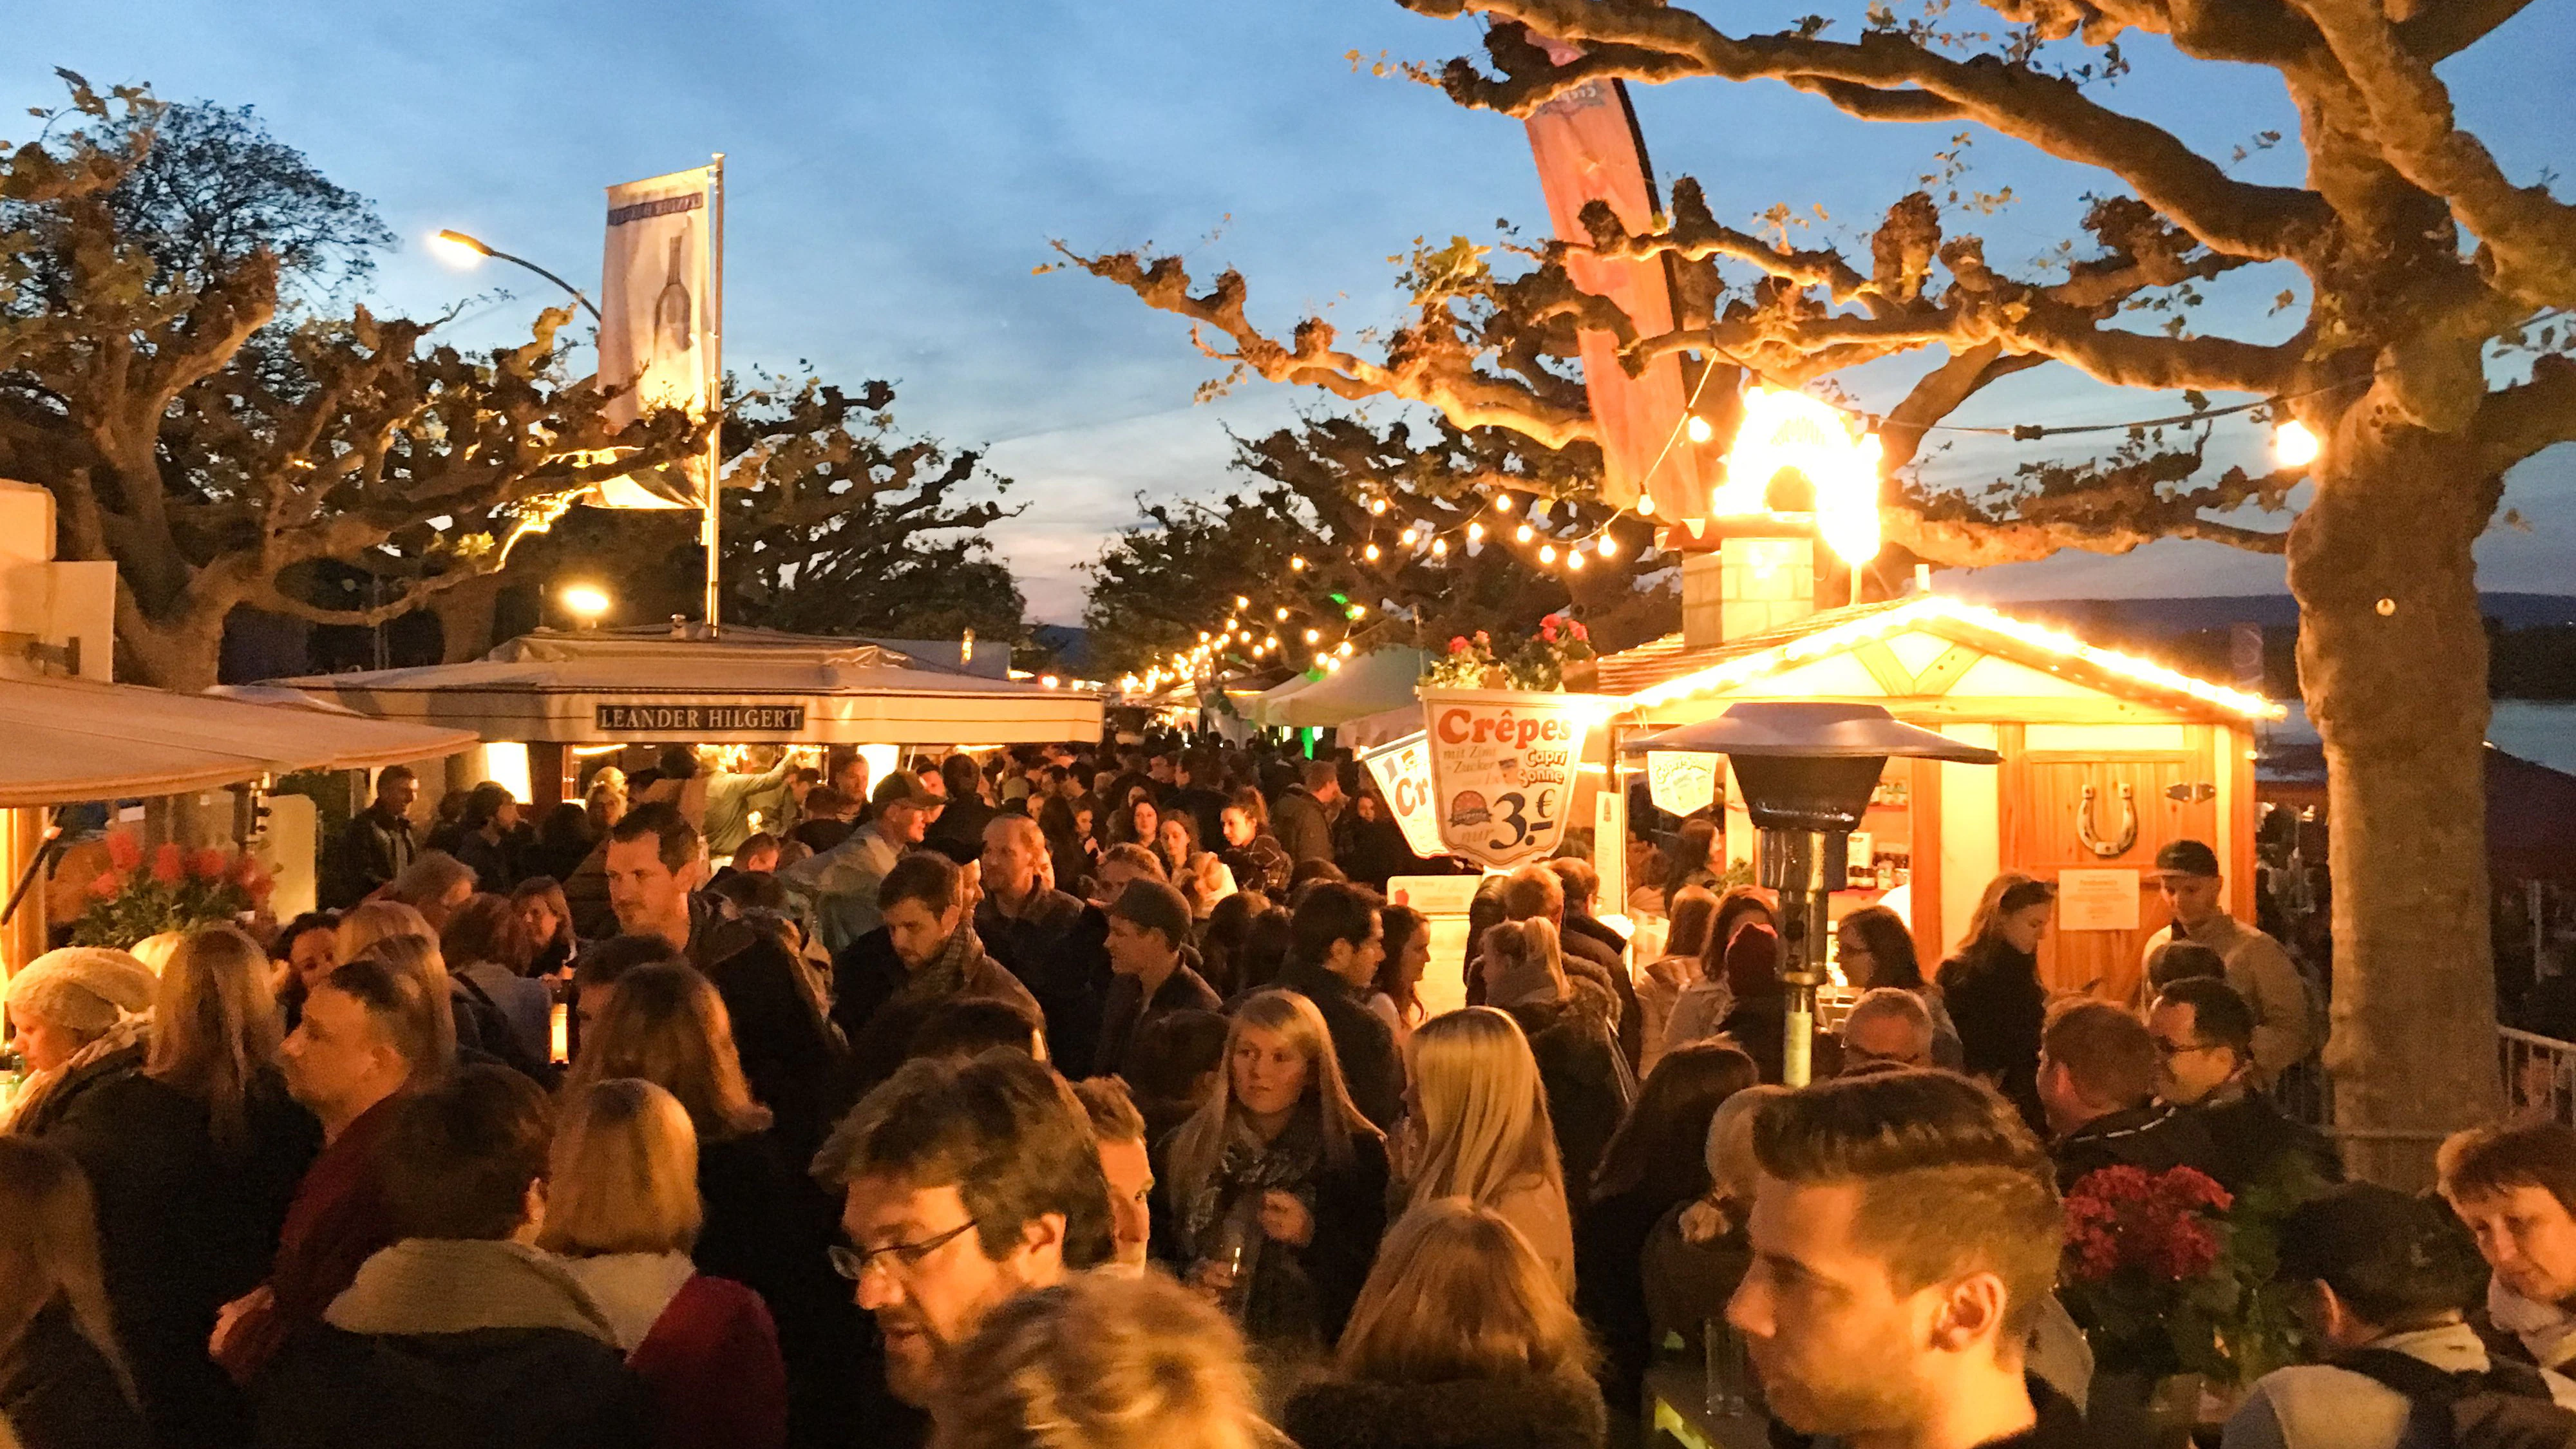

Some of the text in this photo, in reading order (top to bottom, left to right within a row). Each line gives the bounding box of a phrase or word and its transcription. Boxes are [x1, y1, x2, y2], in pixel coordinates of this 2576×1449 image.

[600, 708, 800, 728] LEANDER HILGERT
[1438, 709, 1573, 749] Crêpes
[1524, 748, 1569, 767] Capri
[1517, 769, 1565, 788] Sonne
[1396, 777, 1428, 817] Cr
